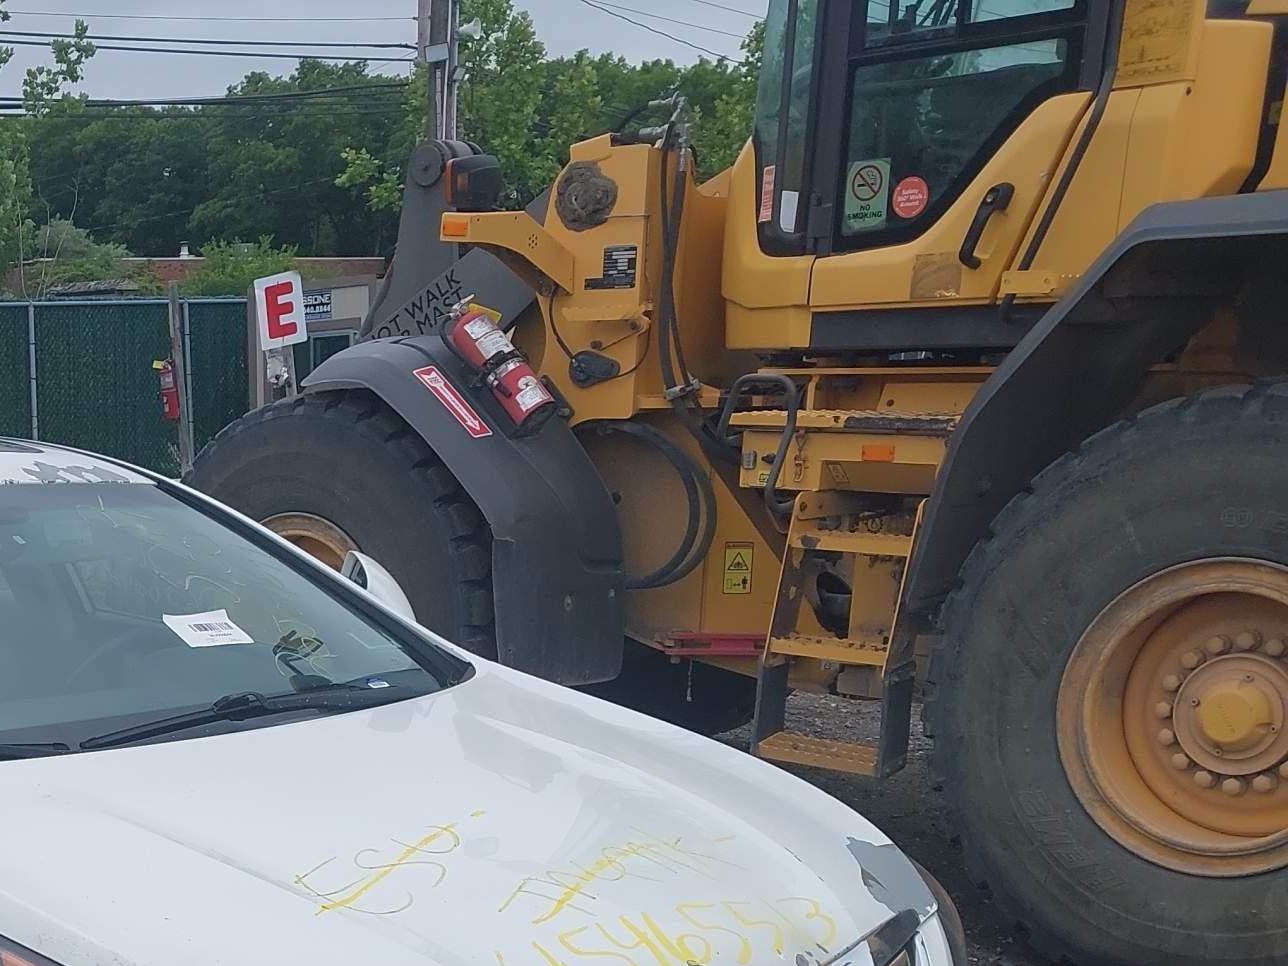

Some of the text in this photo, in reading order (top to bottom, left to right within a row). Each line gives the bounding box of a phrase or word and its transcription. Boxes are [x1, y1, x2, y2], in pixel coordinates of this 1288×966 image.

[847, 211, 883, 220] SMOKING
[859, 203, 871, 211] NO
[404, 269, 461, 320] WALK
[265, 281, 298, 339] E
